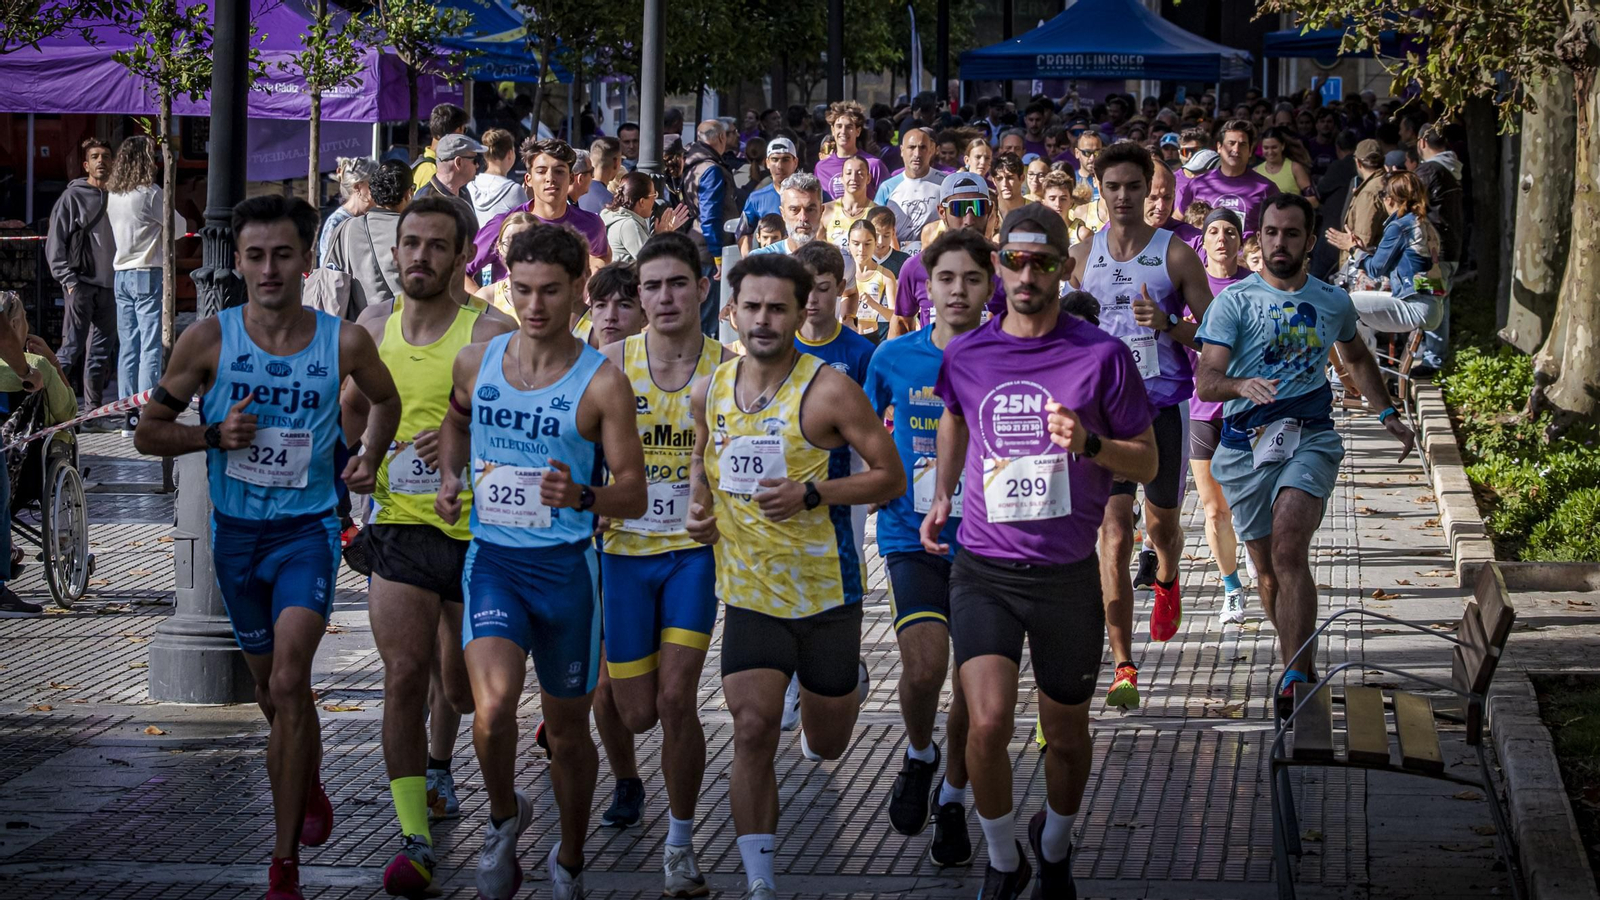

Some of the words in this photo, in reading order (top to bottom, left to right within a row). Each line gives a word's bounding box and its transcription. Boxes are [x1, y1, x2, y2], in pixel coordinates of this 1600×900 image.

[275, 81, 299, 93] Cádiz
[1218, 198, 1239, 207] 25N
[230, 381, 320, 414] nerja
[993, 394, 1042, 414] 25N
[478, 405, 561, 440] nerja
[910, 416, 940, 430] OLIM
[489, 436, 549, 455] ATLETISMO
[248, 445, 288, 467] 324
[730, 455, 764, 474] 378
[239, 463, 258, 472] ROMPE
[488, 484, 526, 506] 325
[1006, 477, 1047, 498] 299
[653, 499, 675, 515] 51
[473, 608, 509, 619] nerja
